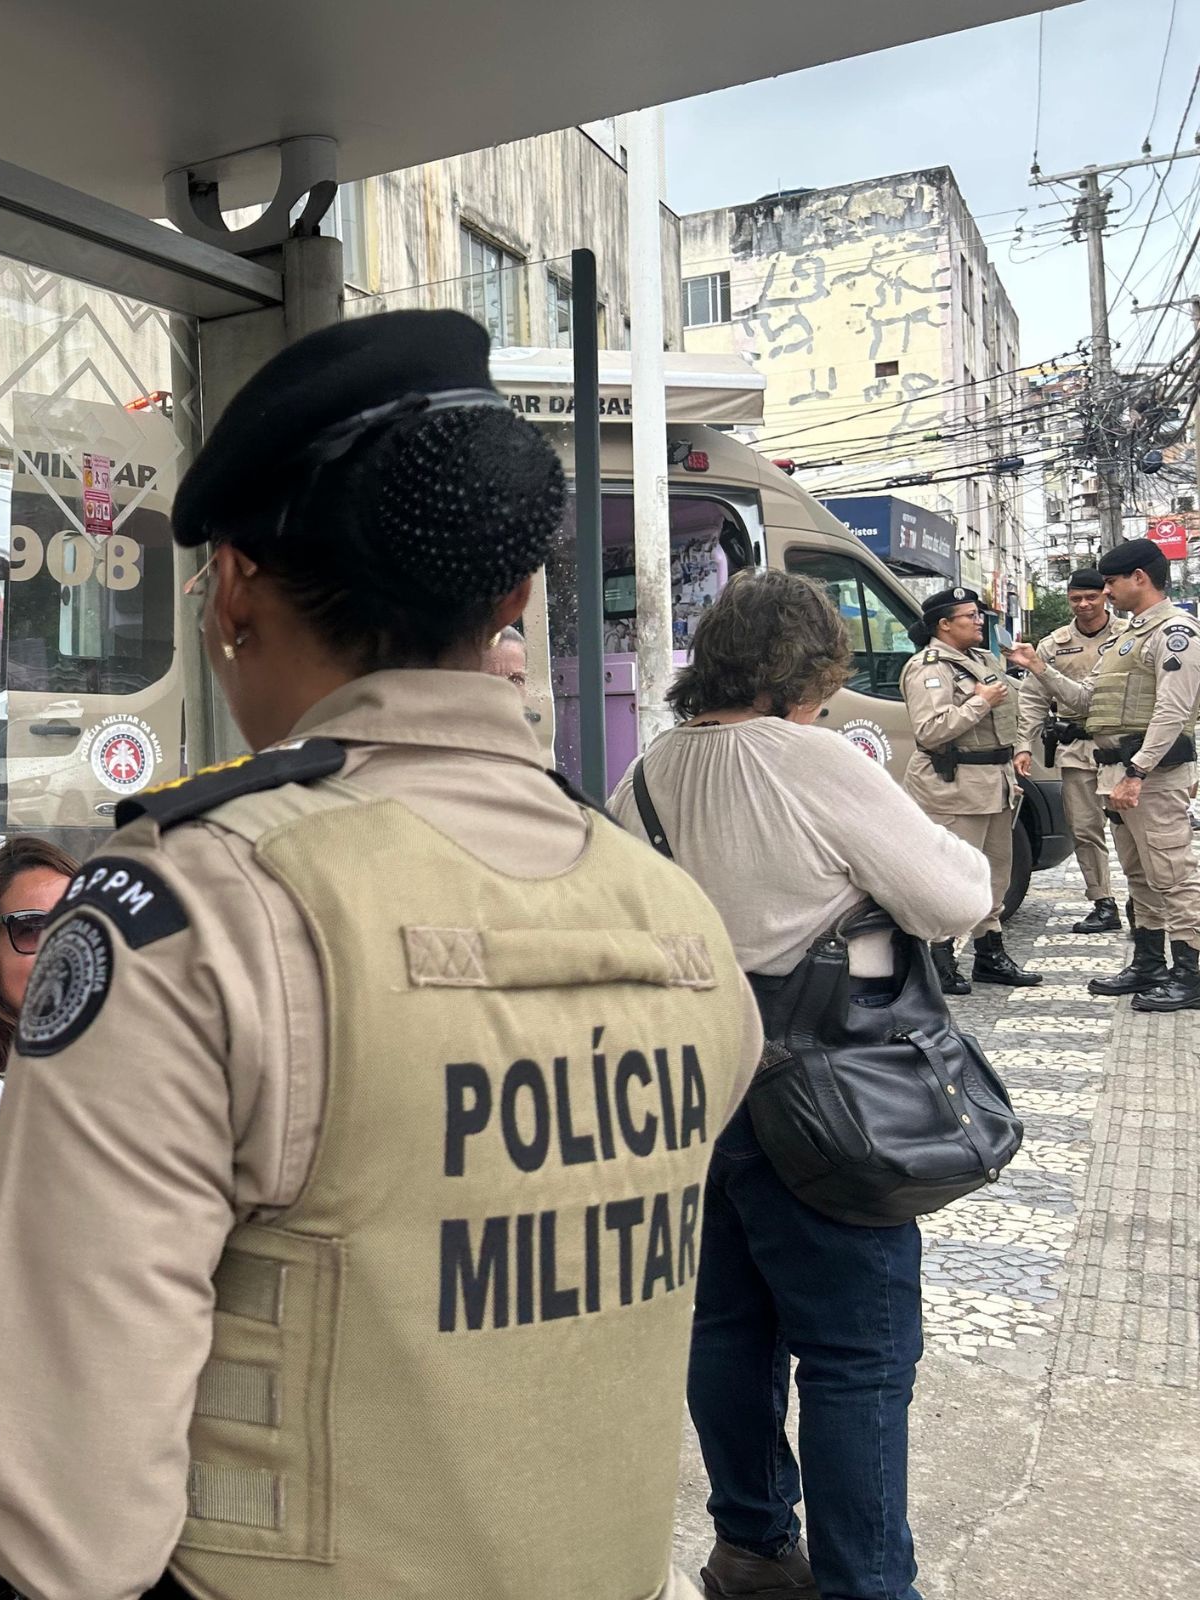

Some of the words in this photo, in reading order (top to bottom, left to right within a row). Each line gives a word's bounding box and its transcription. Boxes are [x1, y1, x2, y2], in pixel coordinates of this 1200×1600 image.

[18, 450, 158, 490] MILAR
[849, 527, 878, 536] tistas
[101, 714, 140, 726] MILITAR
[140, 721, 151, 733] DA
[445, 1026, 706, 1177] POLÍCIA
[438, 1183, 700, 1332] MILITAR
